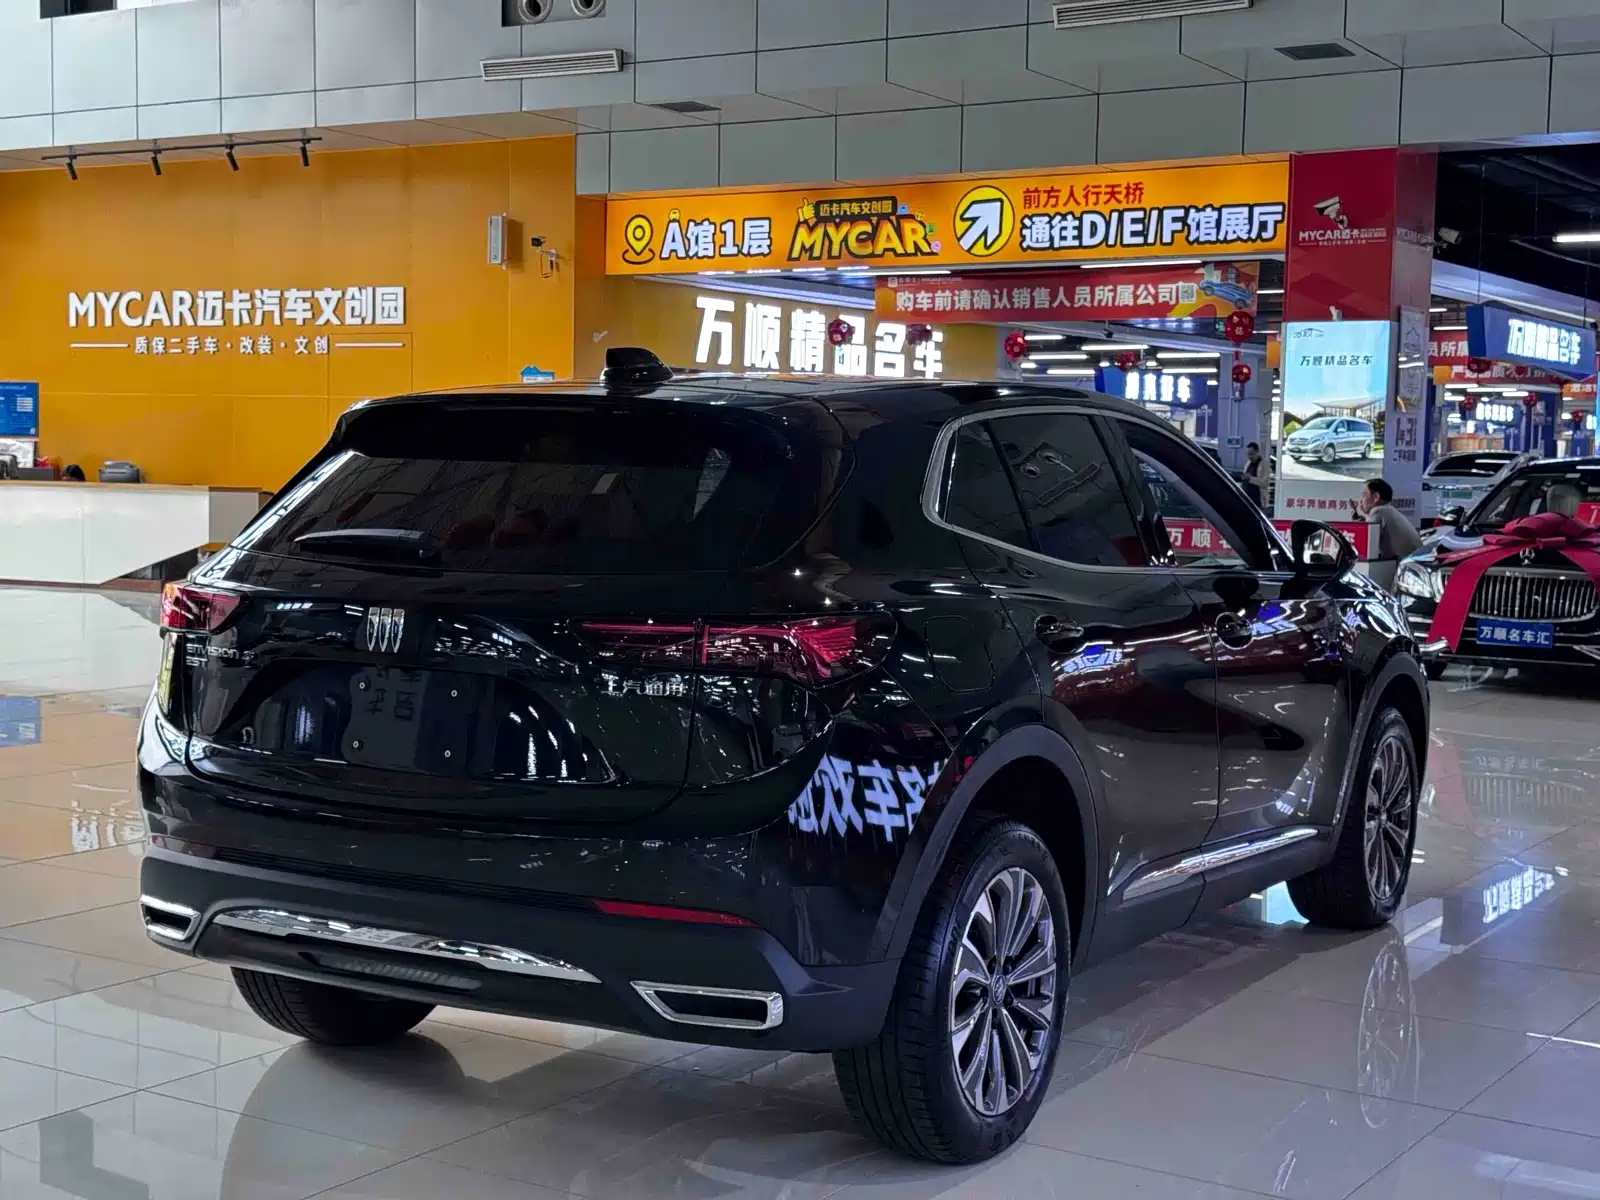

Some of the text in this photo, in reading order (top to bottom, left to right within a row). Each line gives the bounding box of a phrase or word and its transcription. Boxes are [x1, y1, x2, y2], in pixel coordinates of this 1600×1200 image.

[819, 200, 892, 216] 迈卡汽车文创园
[1023, 181, 1145, 209] 前方人行天桥
[660, 218, 771, 259] A馆1层
[790, 219, 936, 261] MYCAR
[1021, 204, 1283, 251] 通往D/E/F馆展厅
[68, 286, 406, 328] MYCAR迈卡汽车文创园
[896, 282, 1179, 313] 购车前请确认销售人员所属公司
[695, 296, 944, 378] 万顺精品名车
[1299, 355, 1374, 367] 万顺精品名车
[1479, 626, 1551, 644] 万顺名车汇
